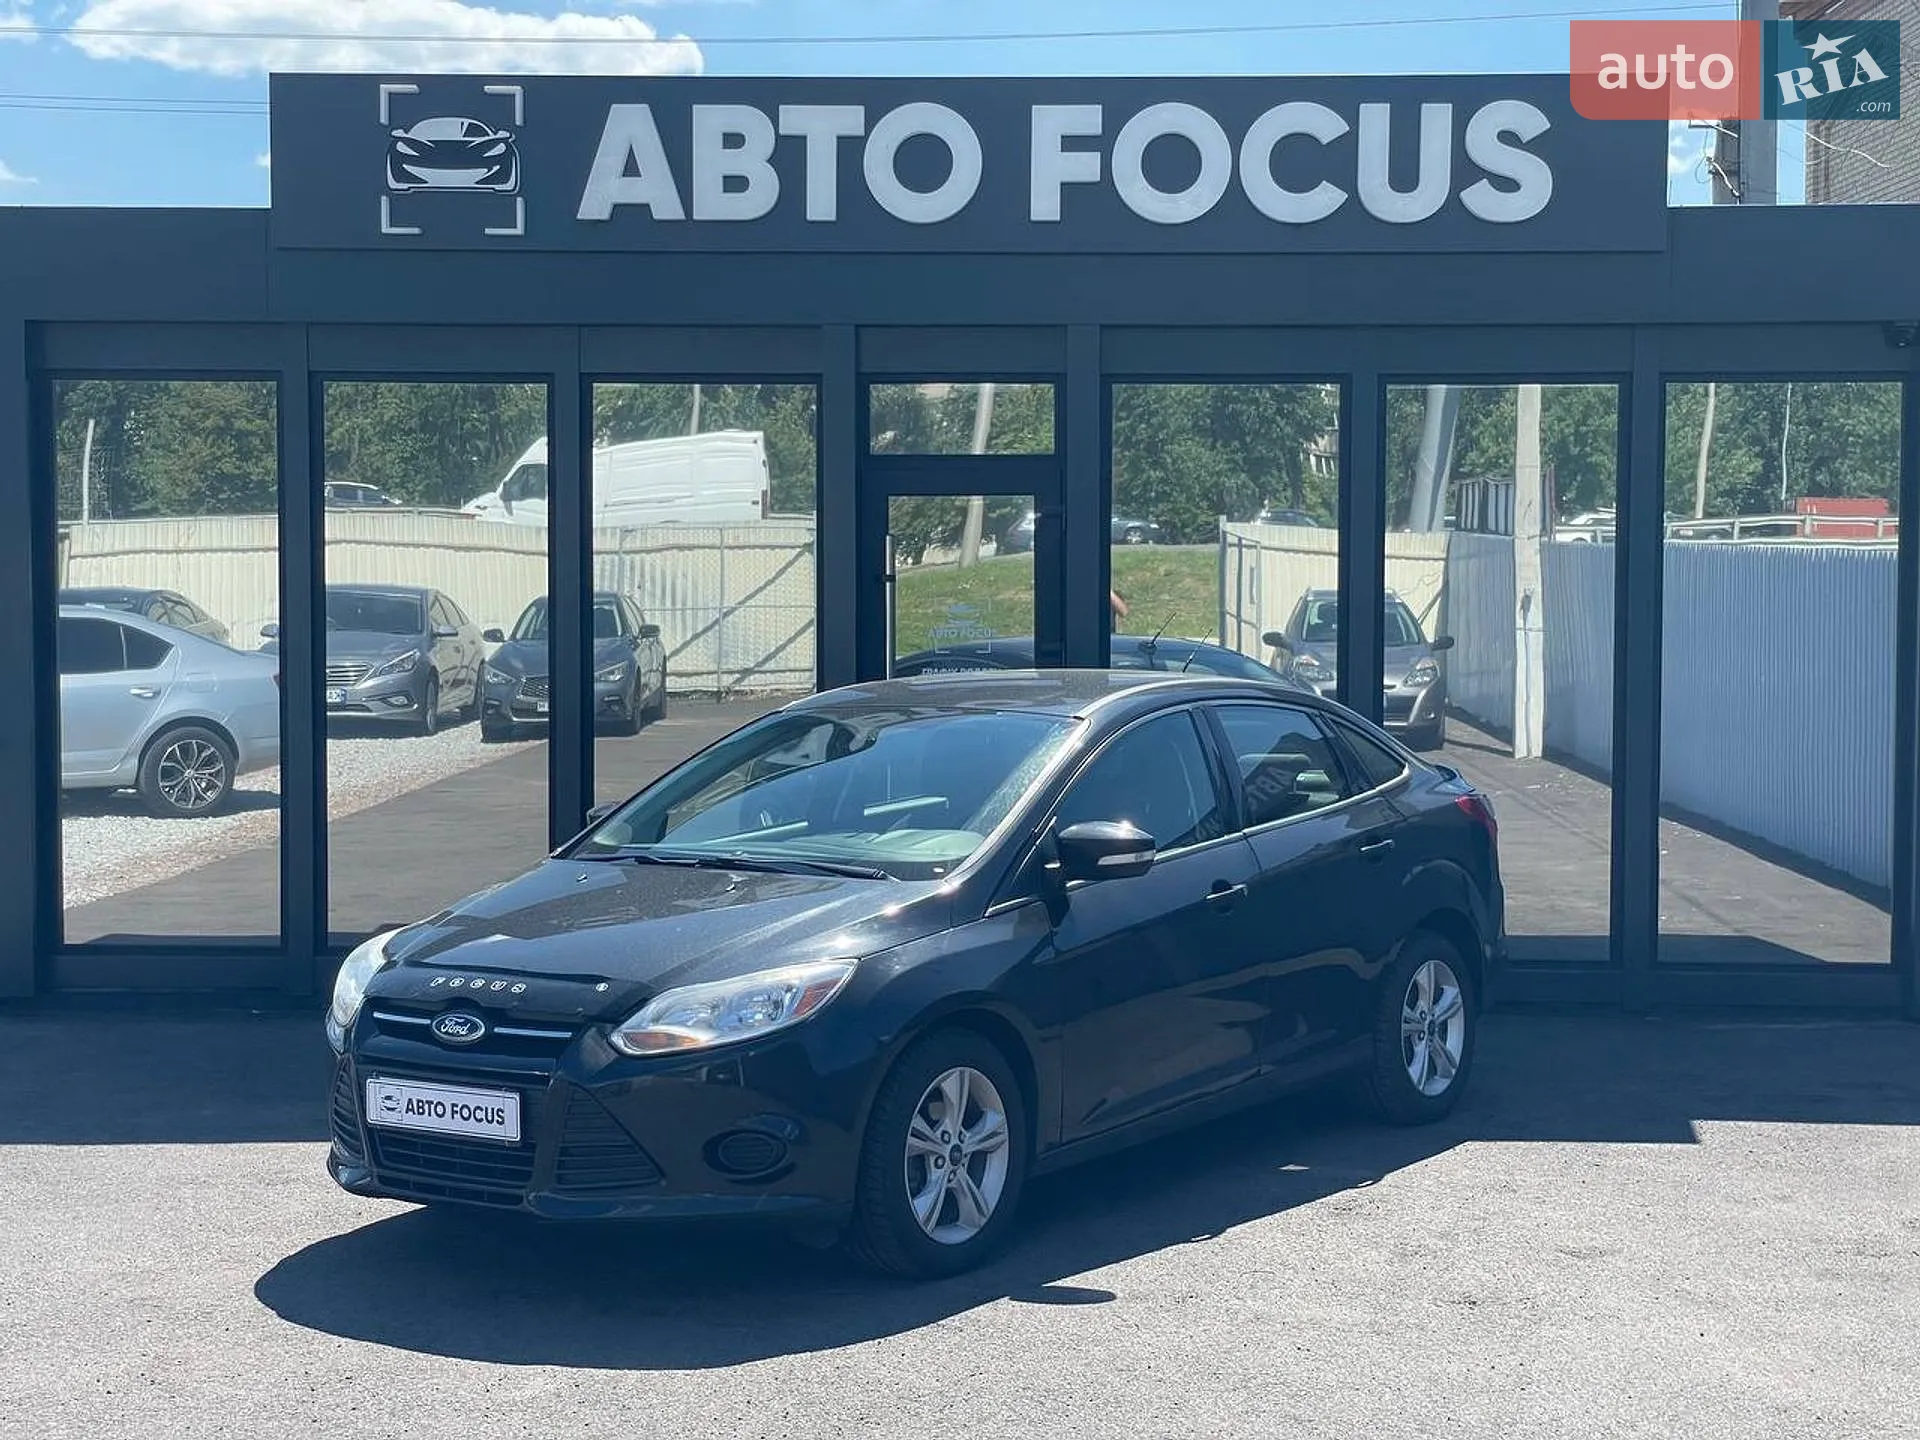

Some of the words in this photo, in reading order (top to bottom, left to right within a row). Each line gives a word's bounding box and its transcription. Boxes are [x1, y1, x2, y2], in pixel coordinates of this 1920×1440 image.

[576, 102, 984, 224] АВТО
[1029, 100, 1554, 224] FOCUS
[440, 1017, 472, 1036] Ford
[405, 1097, 447, 1119] АВТО
[450, 1102, 505, 1126] FOCUS
